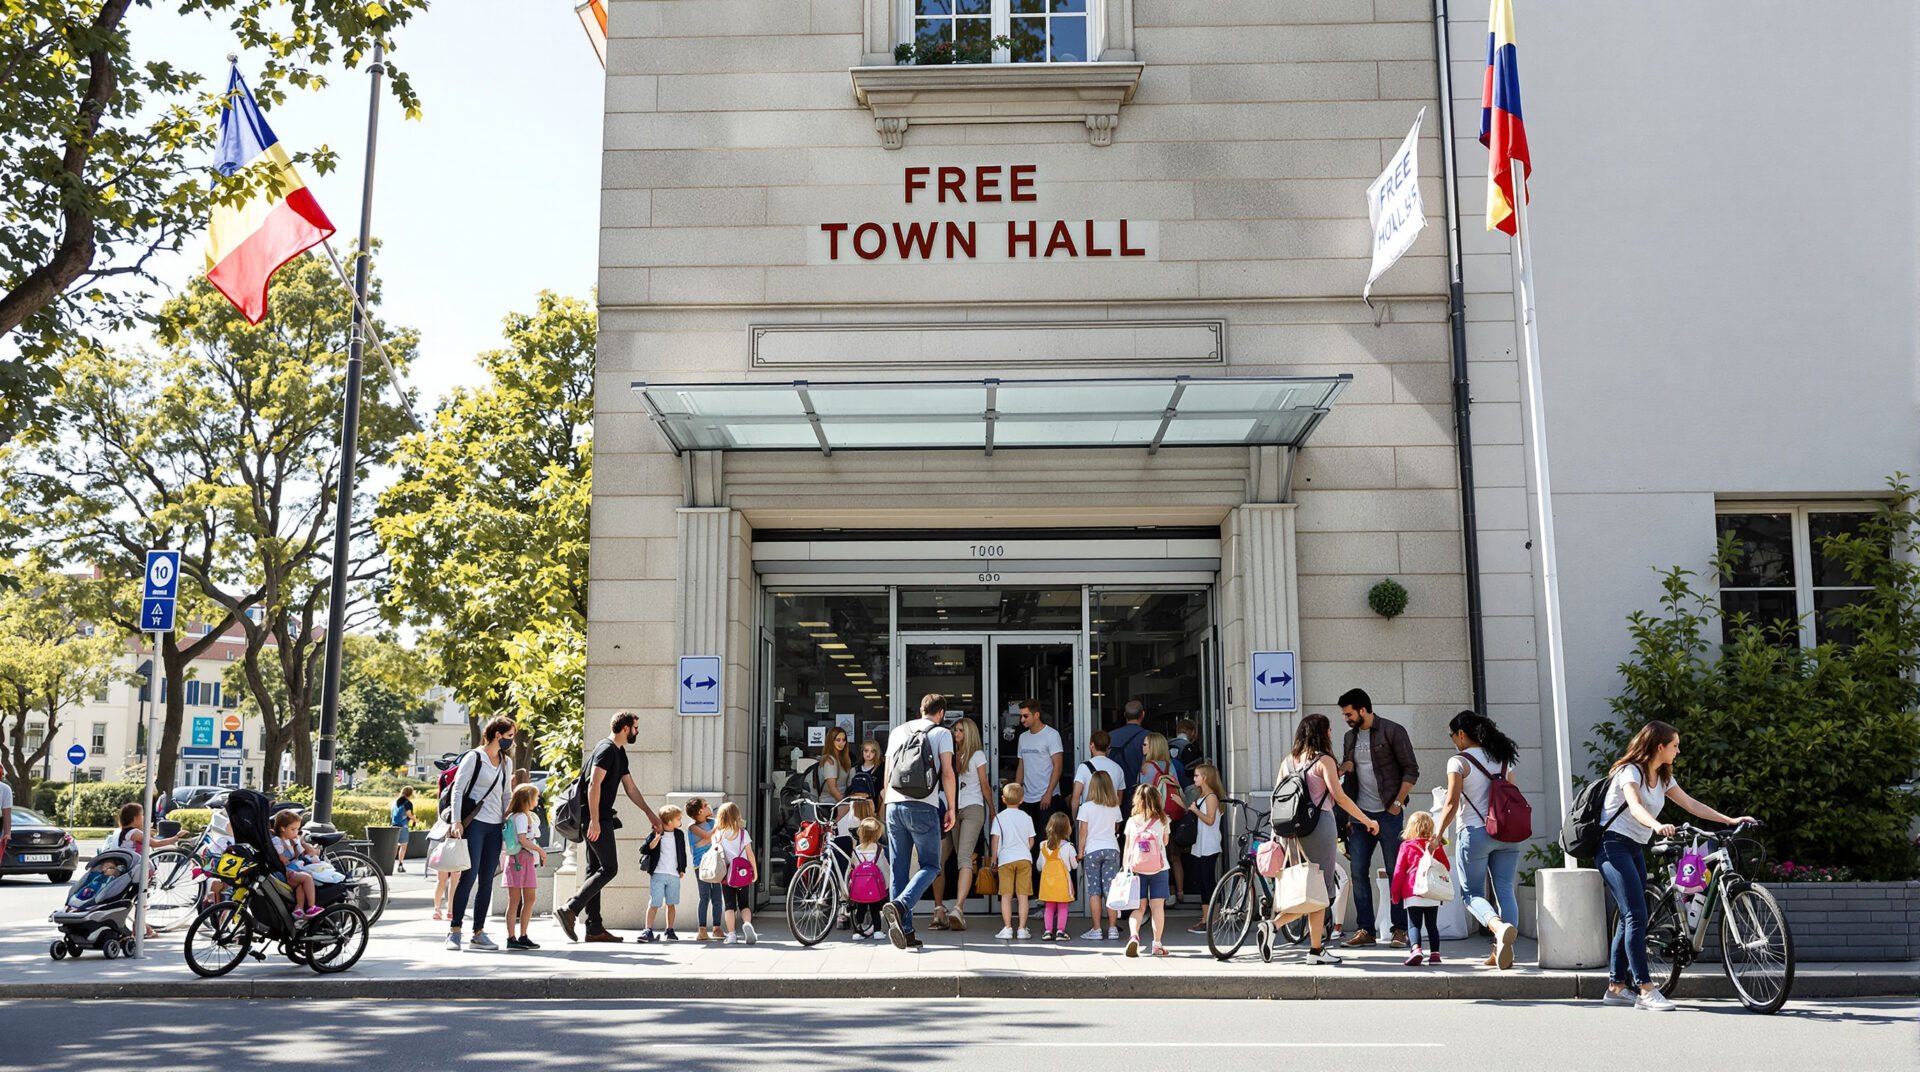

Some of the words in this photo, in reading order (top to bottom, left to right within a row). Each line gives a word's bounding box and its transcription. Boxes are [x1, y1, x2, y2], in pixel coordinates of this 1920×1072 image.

[904, 164, 1037, 203] FREE
[1379, 151, 1411, 211] FREE
[820, 221, 977, 260] TOWN
[1007, 218, 1146, 258] HALL
[155, 565, 168, 580] 10
